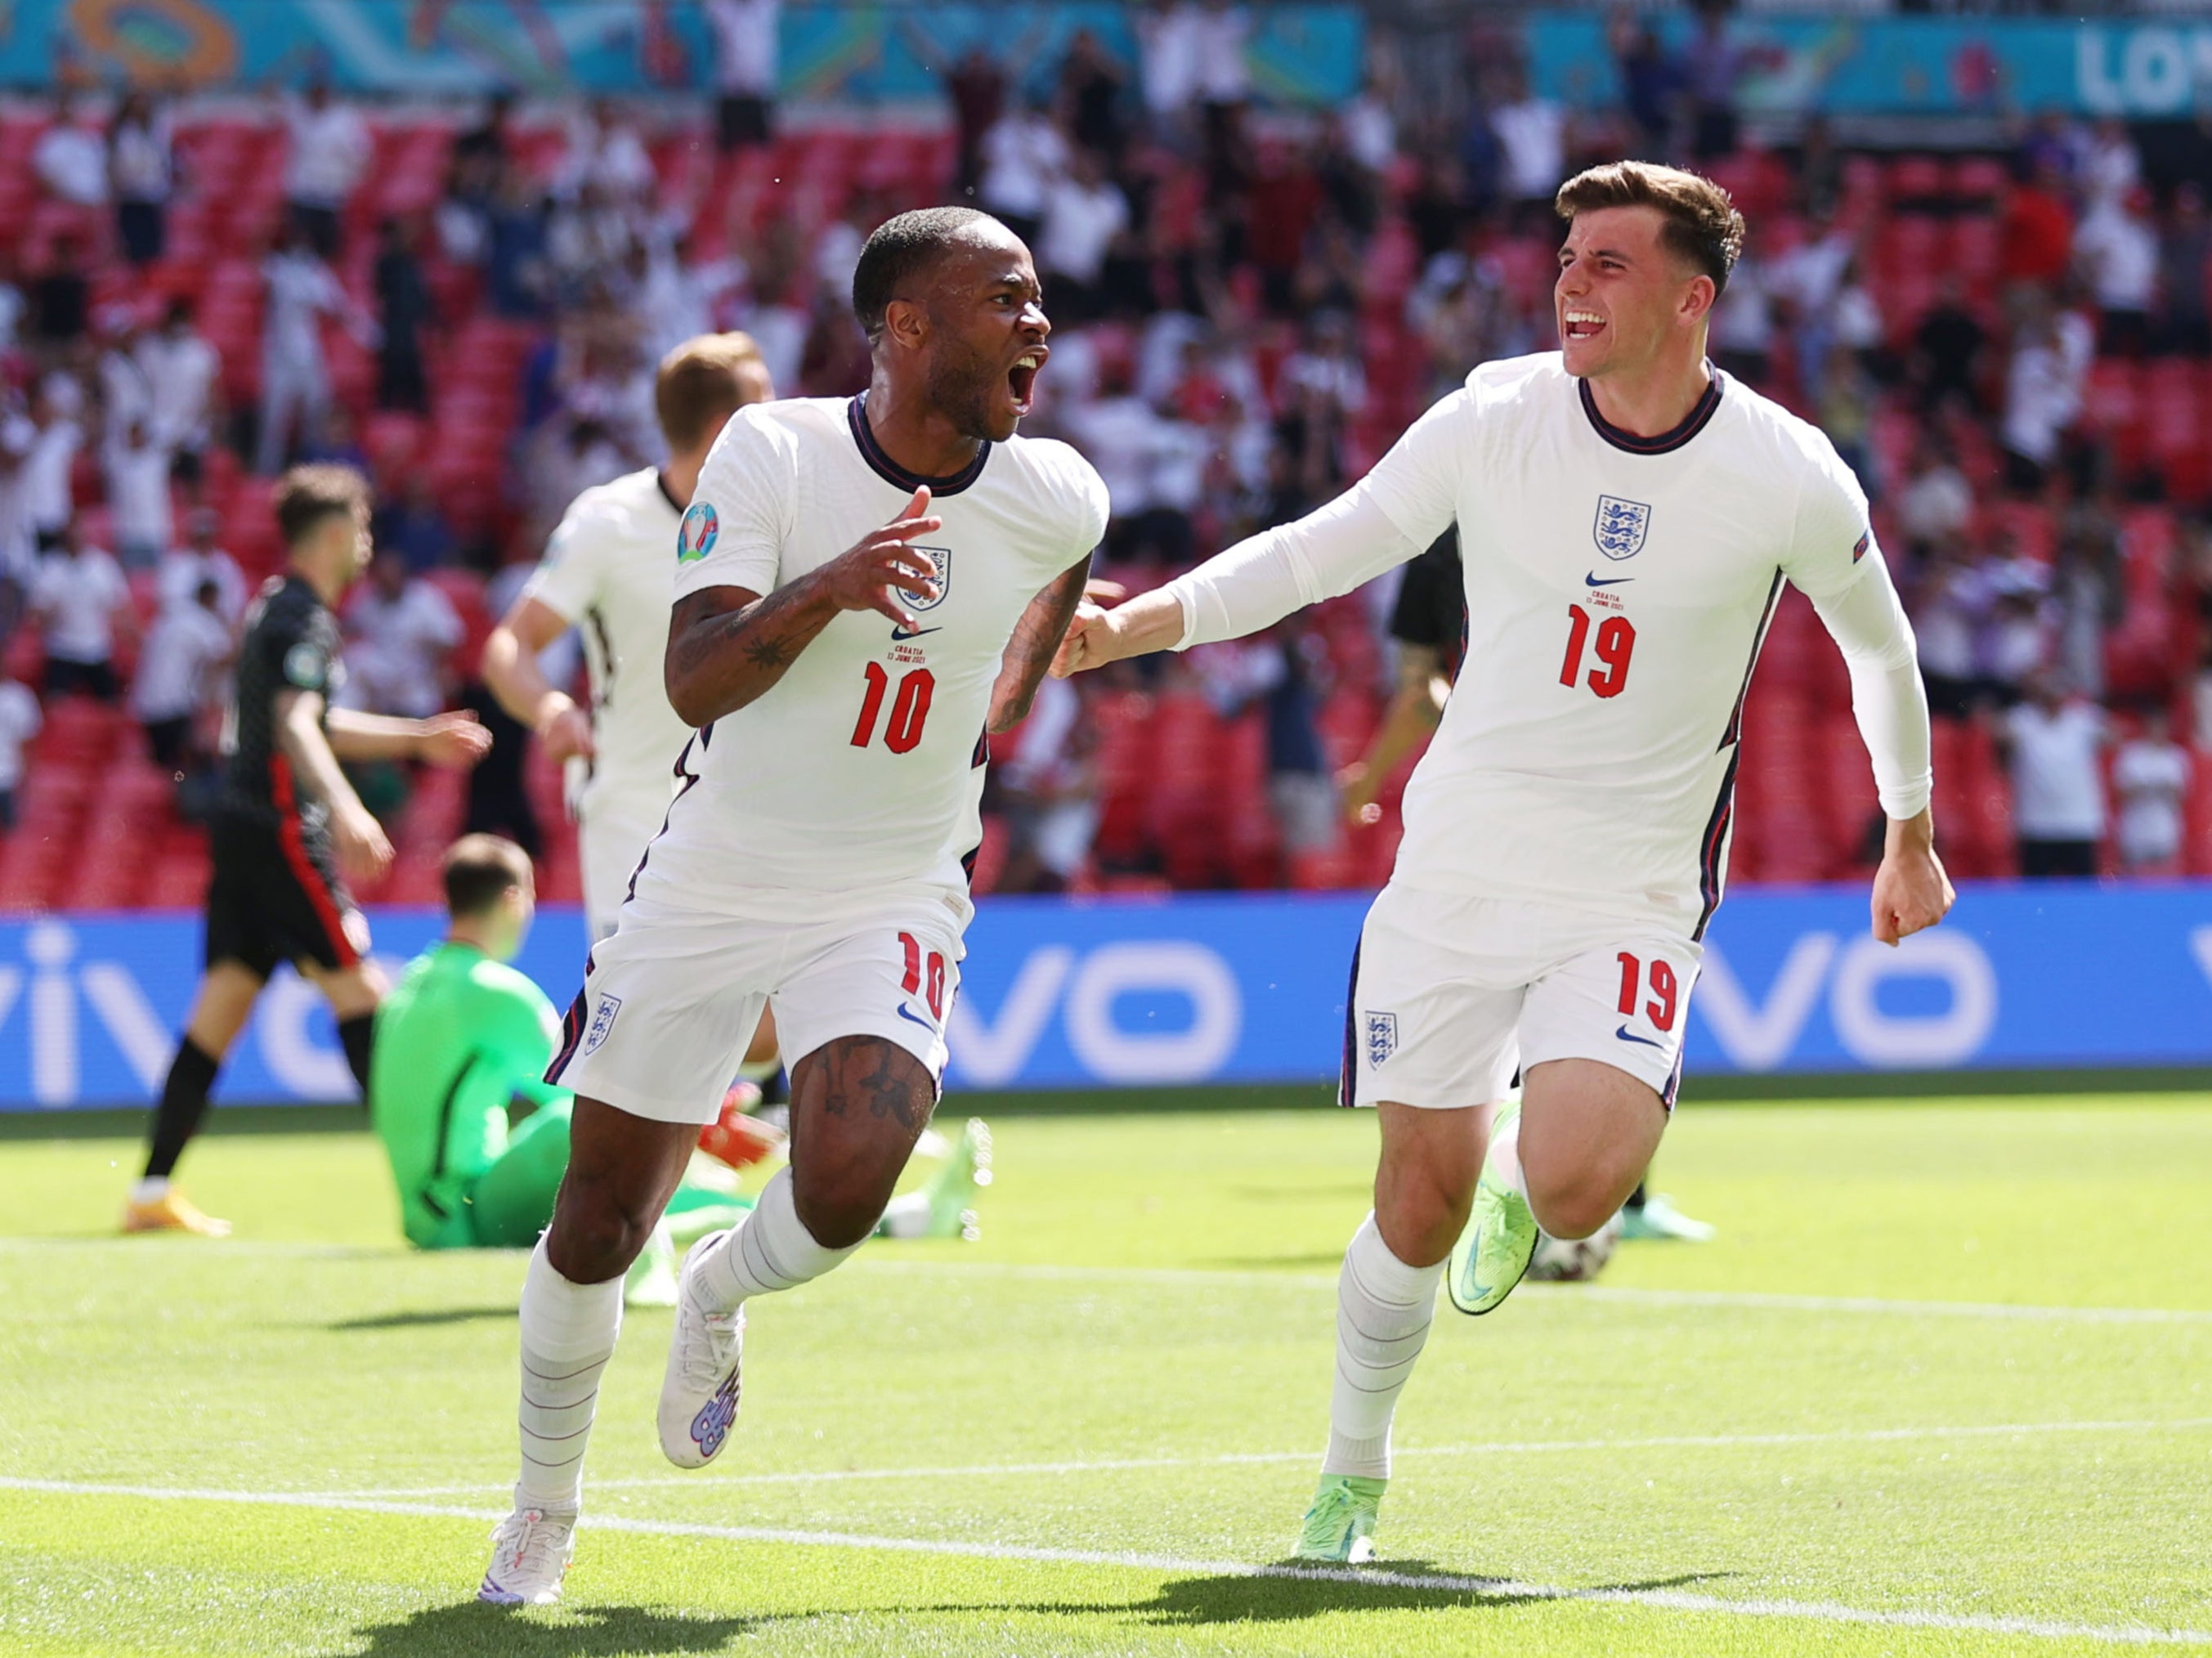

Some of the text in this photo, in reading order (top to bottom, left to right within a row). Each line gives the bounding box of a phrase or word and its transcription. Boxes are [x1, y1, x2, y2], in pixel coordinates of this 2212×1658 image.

[1592, 589, 1619, 603] CROATIA
[894, 644, 924, 655] CROATIA
[895, 654, 911, 663] JUNE
[911, 656, 925, 665] 2021
[1559, 603, 1637, 698] 19
[850, 661, 935, 754] 10
[898, 930, 945, 1023] 10
[1617, 952, 1677, 1033] 19
